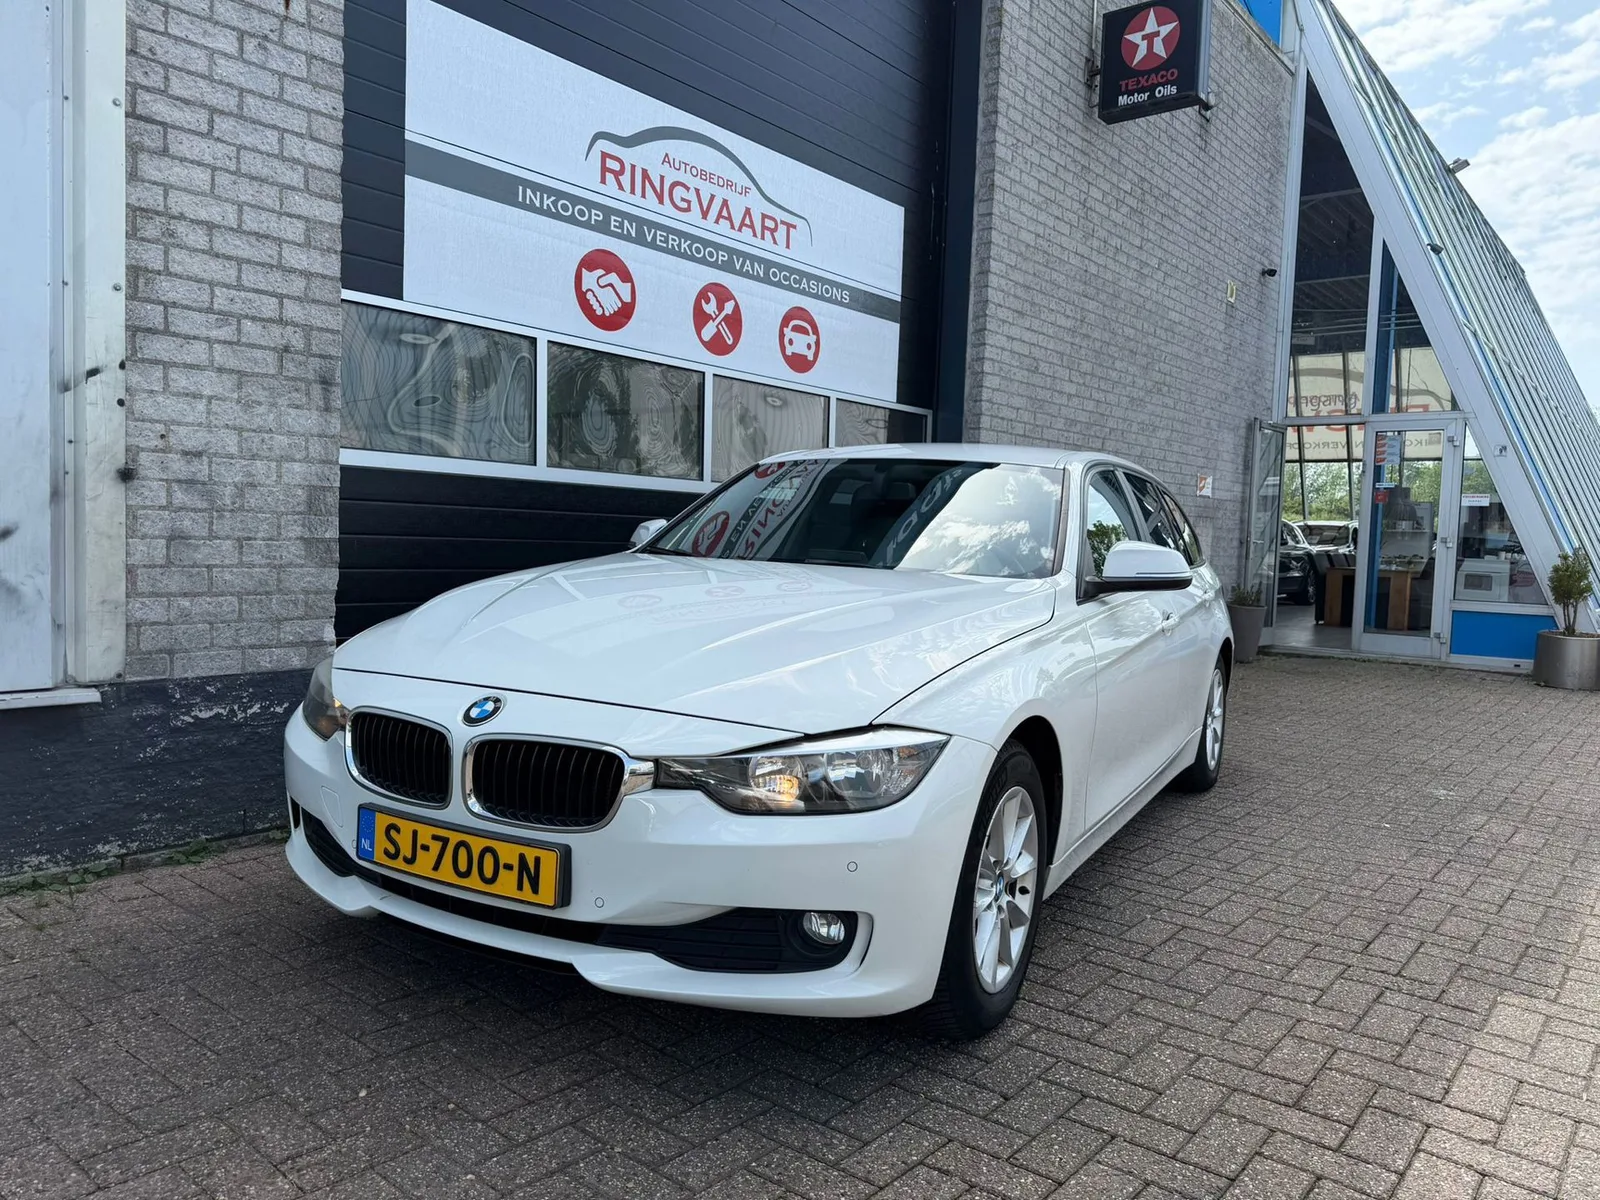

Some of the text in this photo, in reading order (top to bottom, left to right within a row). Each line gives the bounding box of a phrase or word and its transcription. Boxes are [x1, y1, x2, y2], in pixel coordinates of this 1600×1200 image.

[1118, 84, 1178, 106] Motor Oils
[1120, 69, 1178, 91] TEXACO
[661, 152, 752, 198] AUTOBEDRIJF
[599, 150, 797, 249] RINGVAART
[518, 186, 850, 303] INKOOP EN VERKOOP VAN OCCASIONS
[361, 838, 373, 851] NL
[383, 822, 541, 895] SJ-700-N
